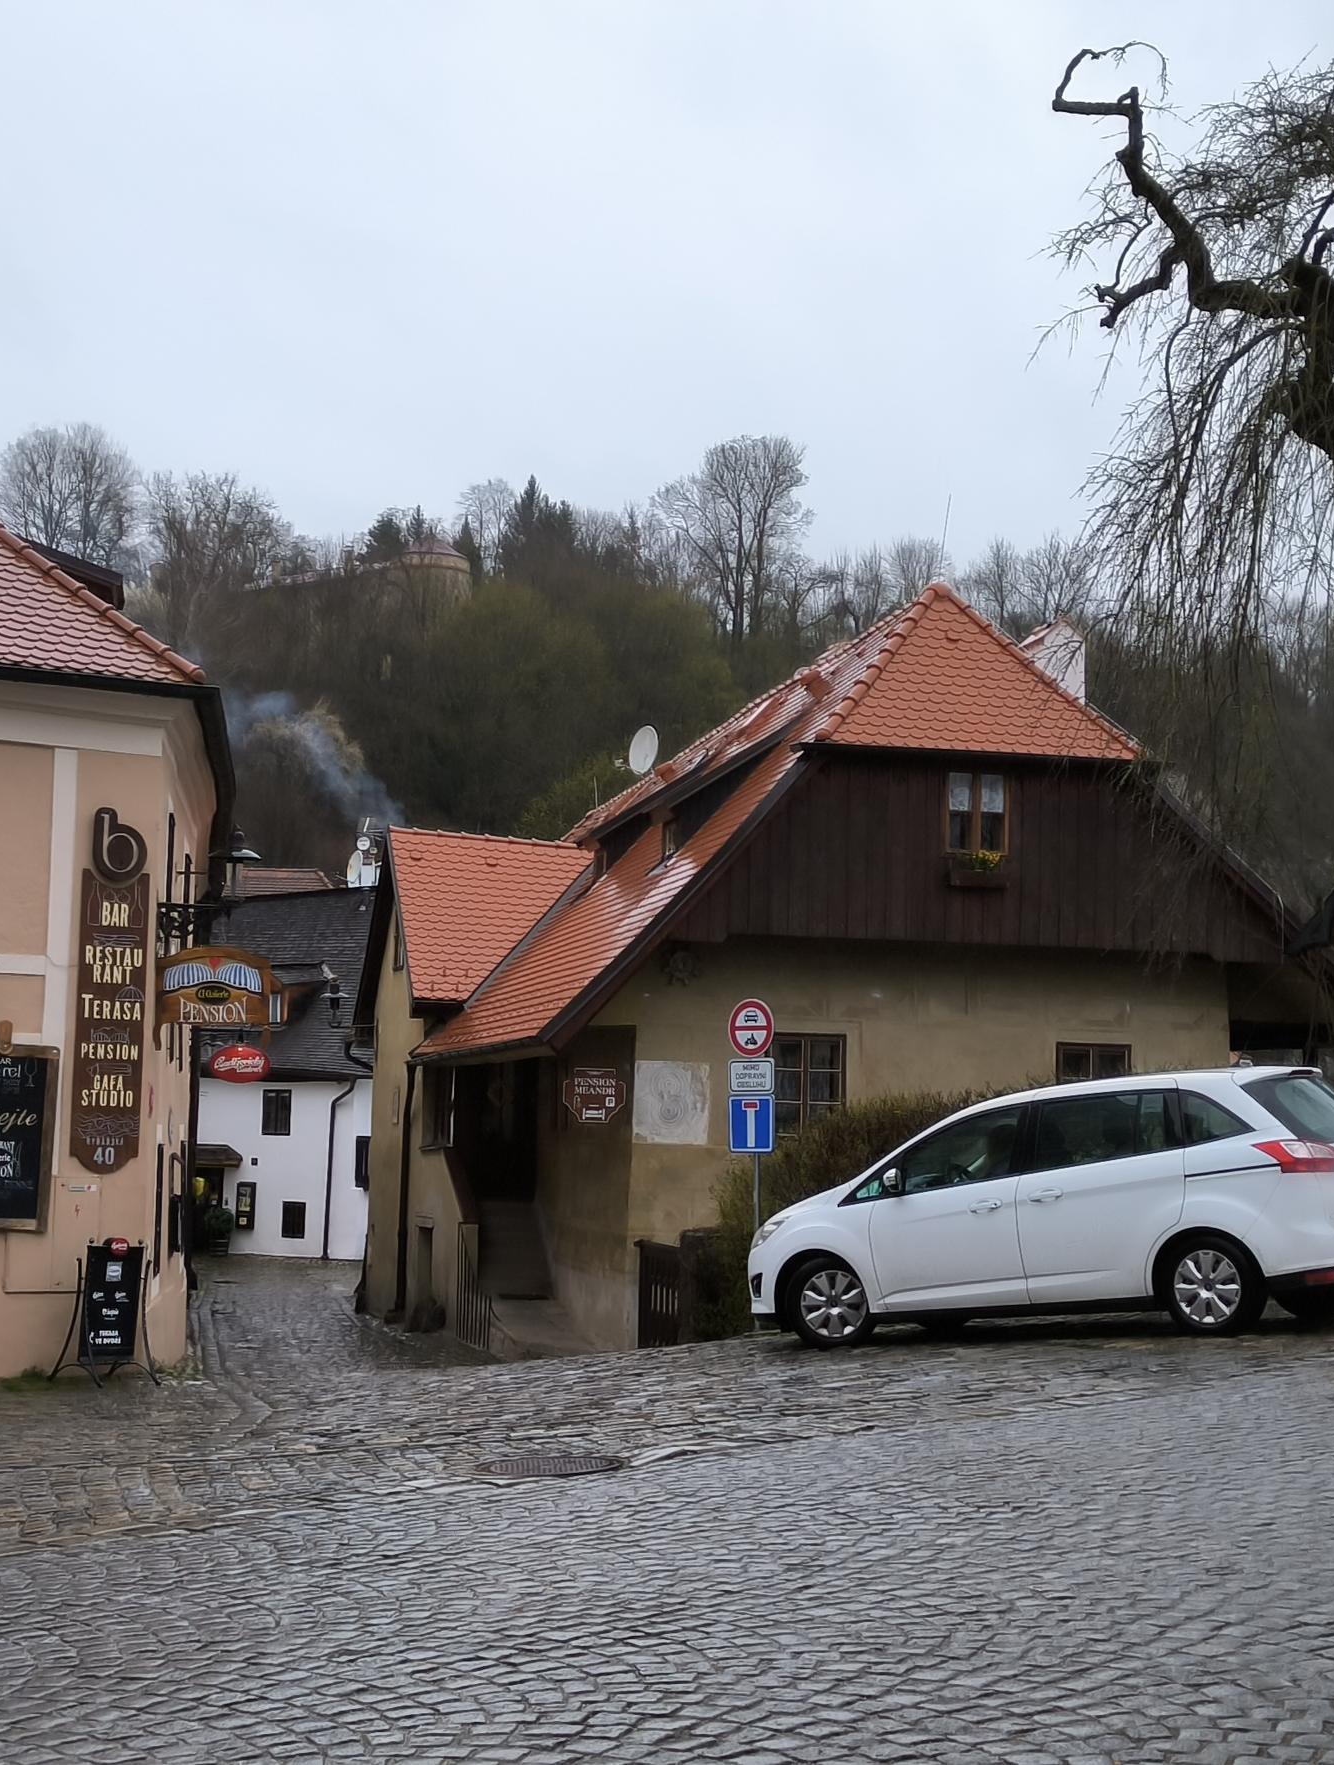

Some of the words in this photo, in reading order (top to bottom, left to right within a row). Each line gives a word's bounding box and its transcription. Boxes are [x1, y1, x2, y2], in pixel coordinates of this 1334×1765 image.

[101, 902, 129, 928] BAR
[85, 945, 143, 968] RESTAU
[93, 964, 133, 986] RANT
[179, 996, 247, 1023] PENSION
[81, 1043, 139, 1061] PENSION
[574, 1078, 617, 1087] PENSION
[574, 1086, 616, 1095] MEANDR
[81, 1090, 134, 1107] STUDIO
[93, 1147, 116, 1165] 40
